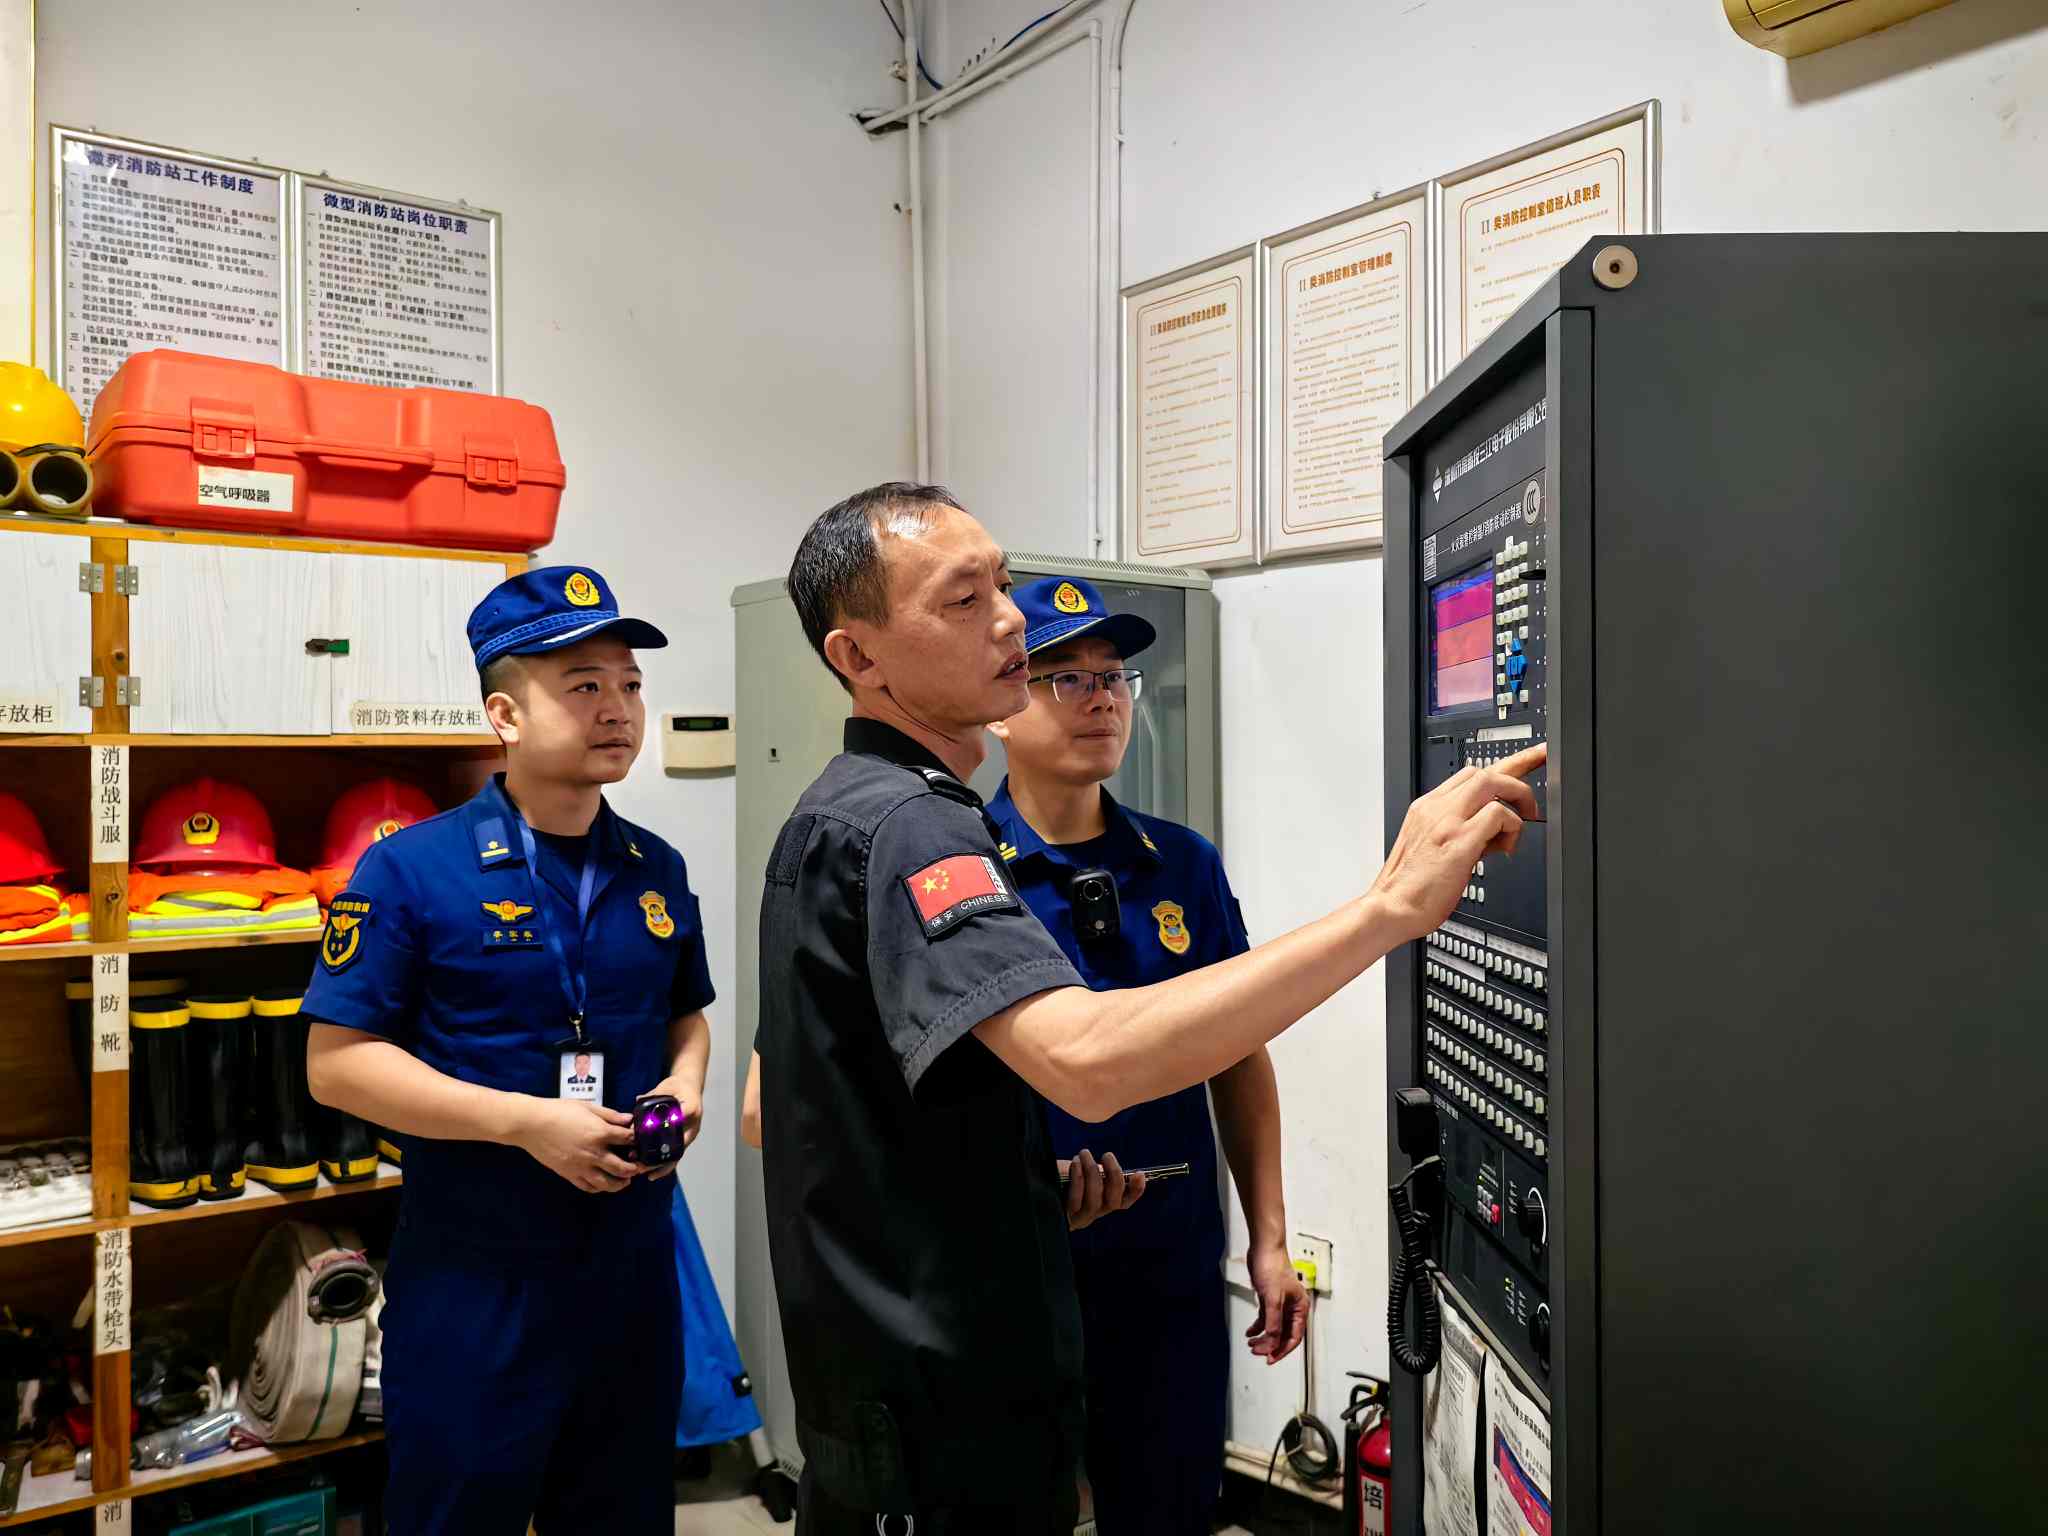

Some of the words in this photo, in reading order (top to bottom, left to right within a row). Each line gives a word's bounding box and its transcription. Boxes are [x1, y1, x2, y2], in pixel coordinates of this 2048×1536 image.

[87, 149, 255, 194] 微型消防站工作制度
[323, 193, 469, 234] 微型消防站岗位职责
[199, 484, 271, 503] 空气呼吸器
[356, 708, 483, 726] 消防资料存放柜
[100, 746, 121, 844] 消防战斗服
[960, 894, 1009, 910] CHINESE
[931, 910, 954, 927] 保安
[100, 955, 121, 1053] 消防靴
[104, 1230, 124, 1349] 消防水带枪头
[104, 1501, 122, 1522] 消
